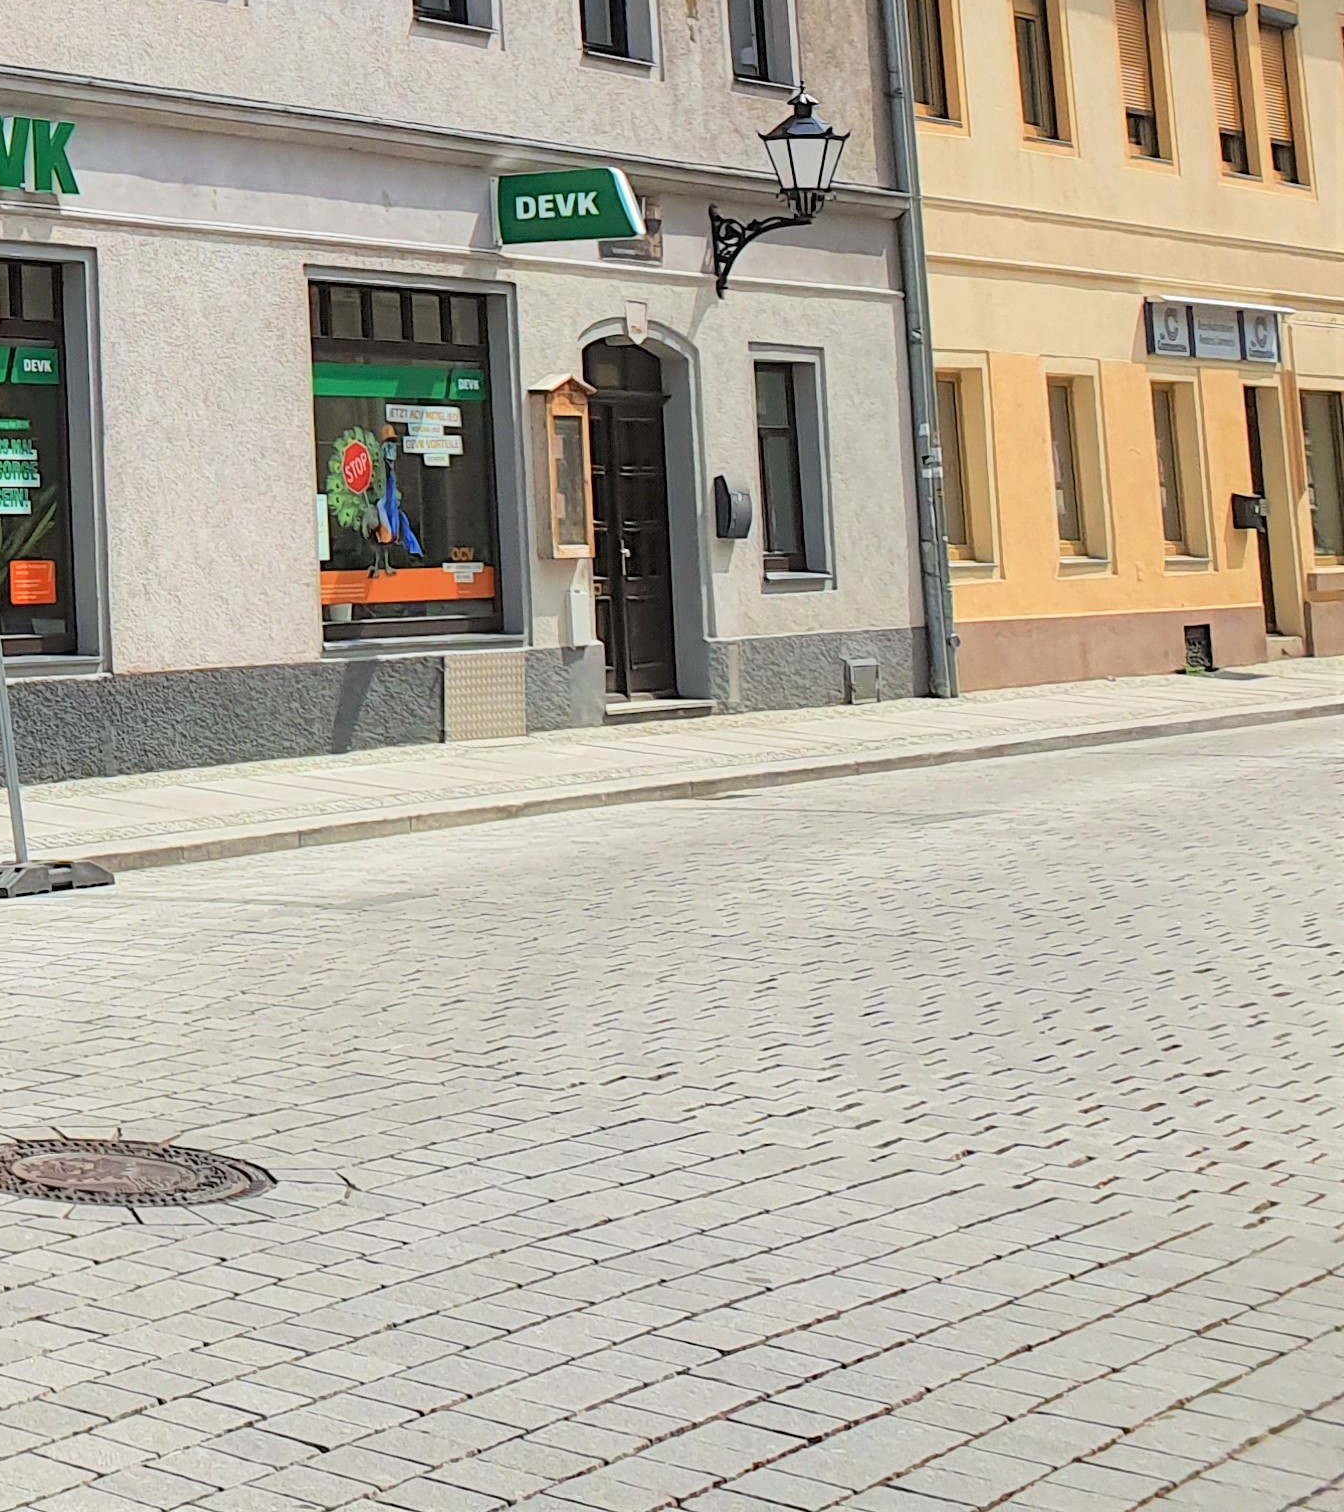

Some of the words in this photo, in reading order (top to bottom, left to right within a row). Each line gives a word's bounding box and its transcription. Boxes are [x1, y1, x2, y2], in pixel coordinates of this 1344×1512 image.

[515, 191, 600, 220] DEVK
[23, 358, 52, 373] DEVK
[345, 452, 368, 484] STOP
